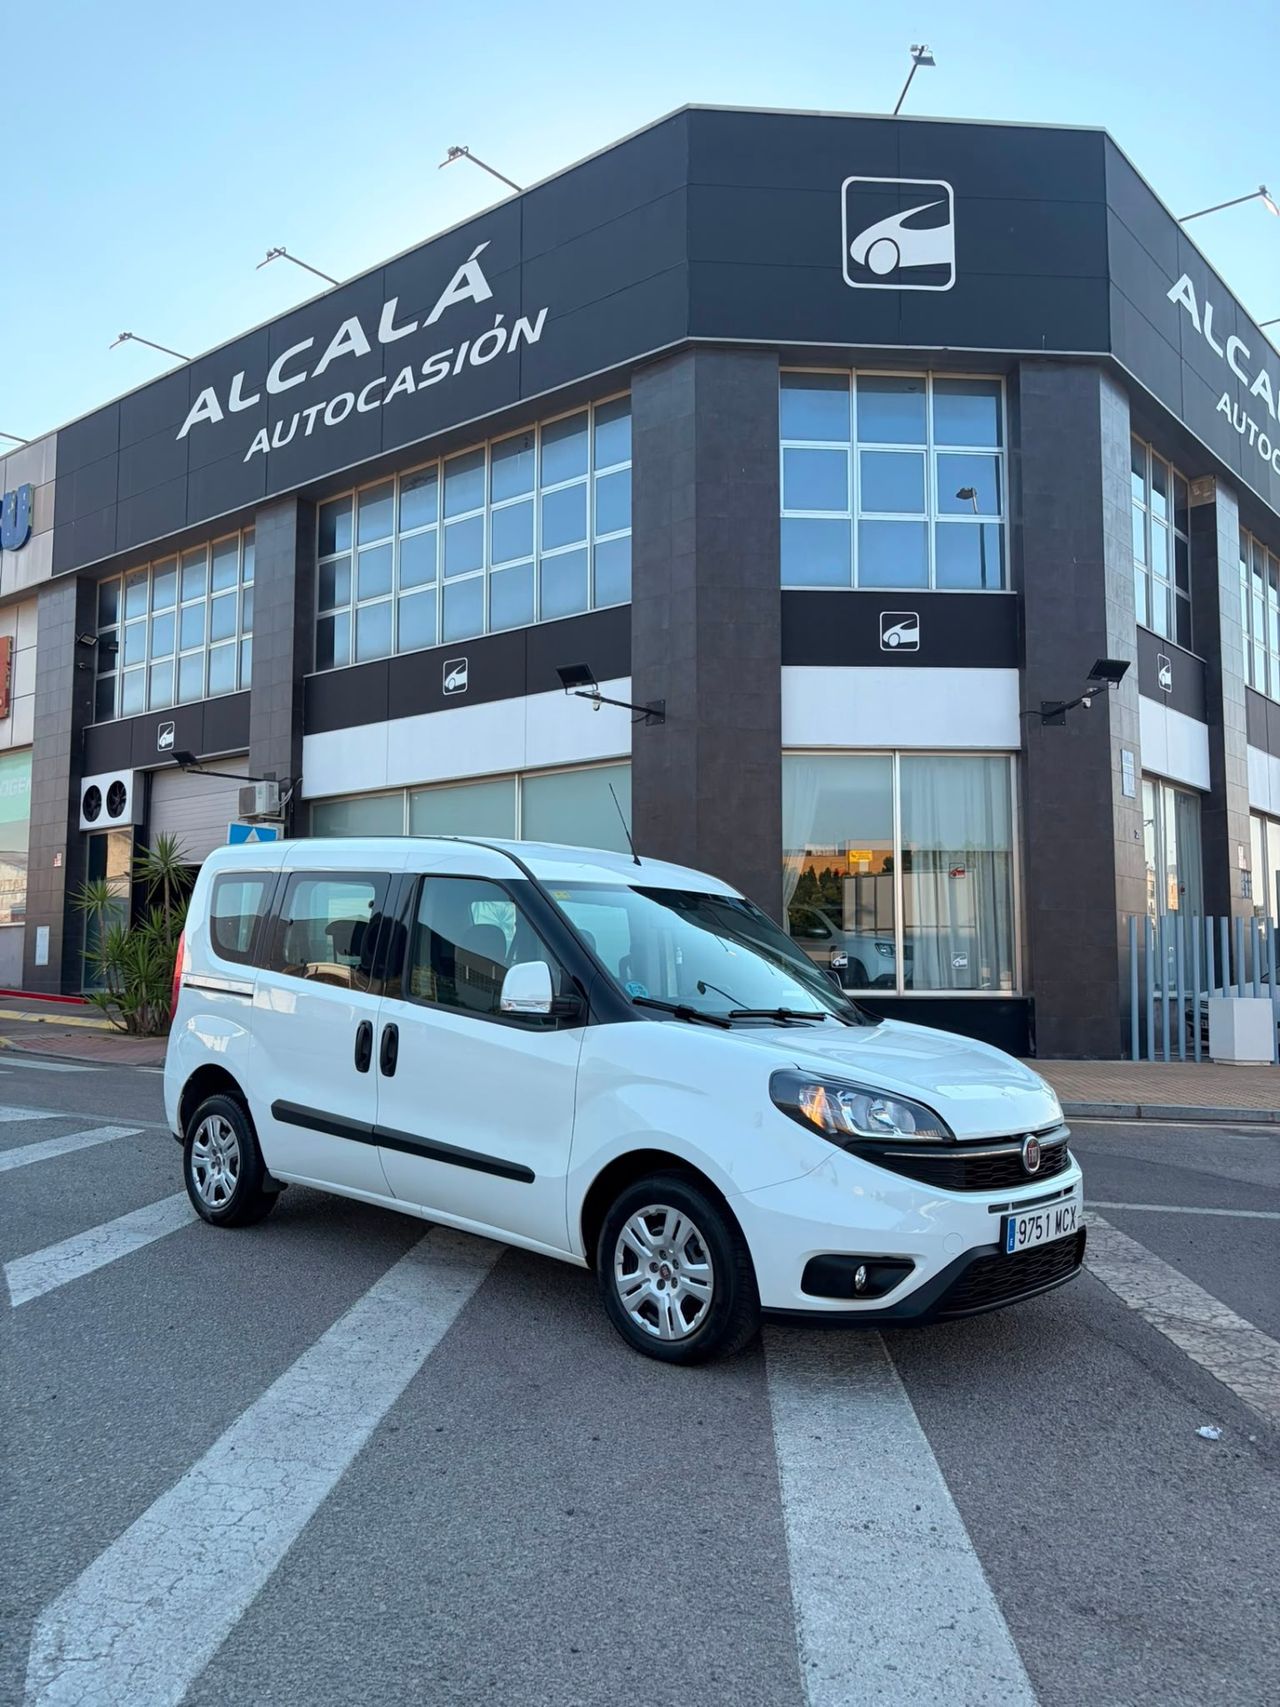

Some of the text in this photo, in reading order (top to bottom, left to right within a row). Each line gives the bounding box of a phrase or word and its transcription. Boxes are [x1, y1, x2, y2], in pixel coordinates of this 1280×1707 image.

[176, 240, 493, 440] ALCALÁ
[243, 307, 549, 463] AUTOCASIÓN
[1166, 273, 1280, 424] ALCA
[1018, 1213, 1050, 1245] 9751
[1055, 1205, 1077, 1235] MCX
